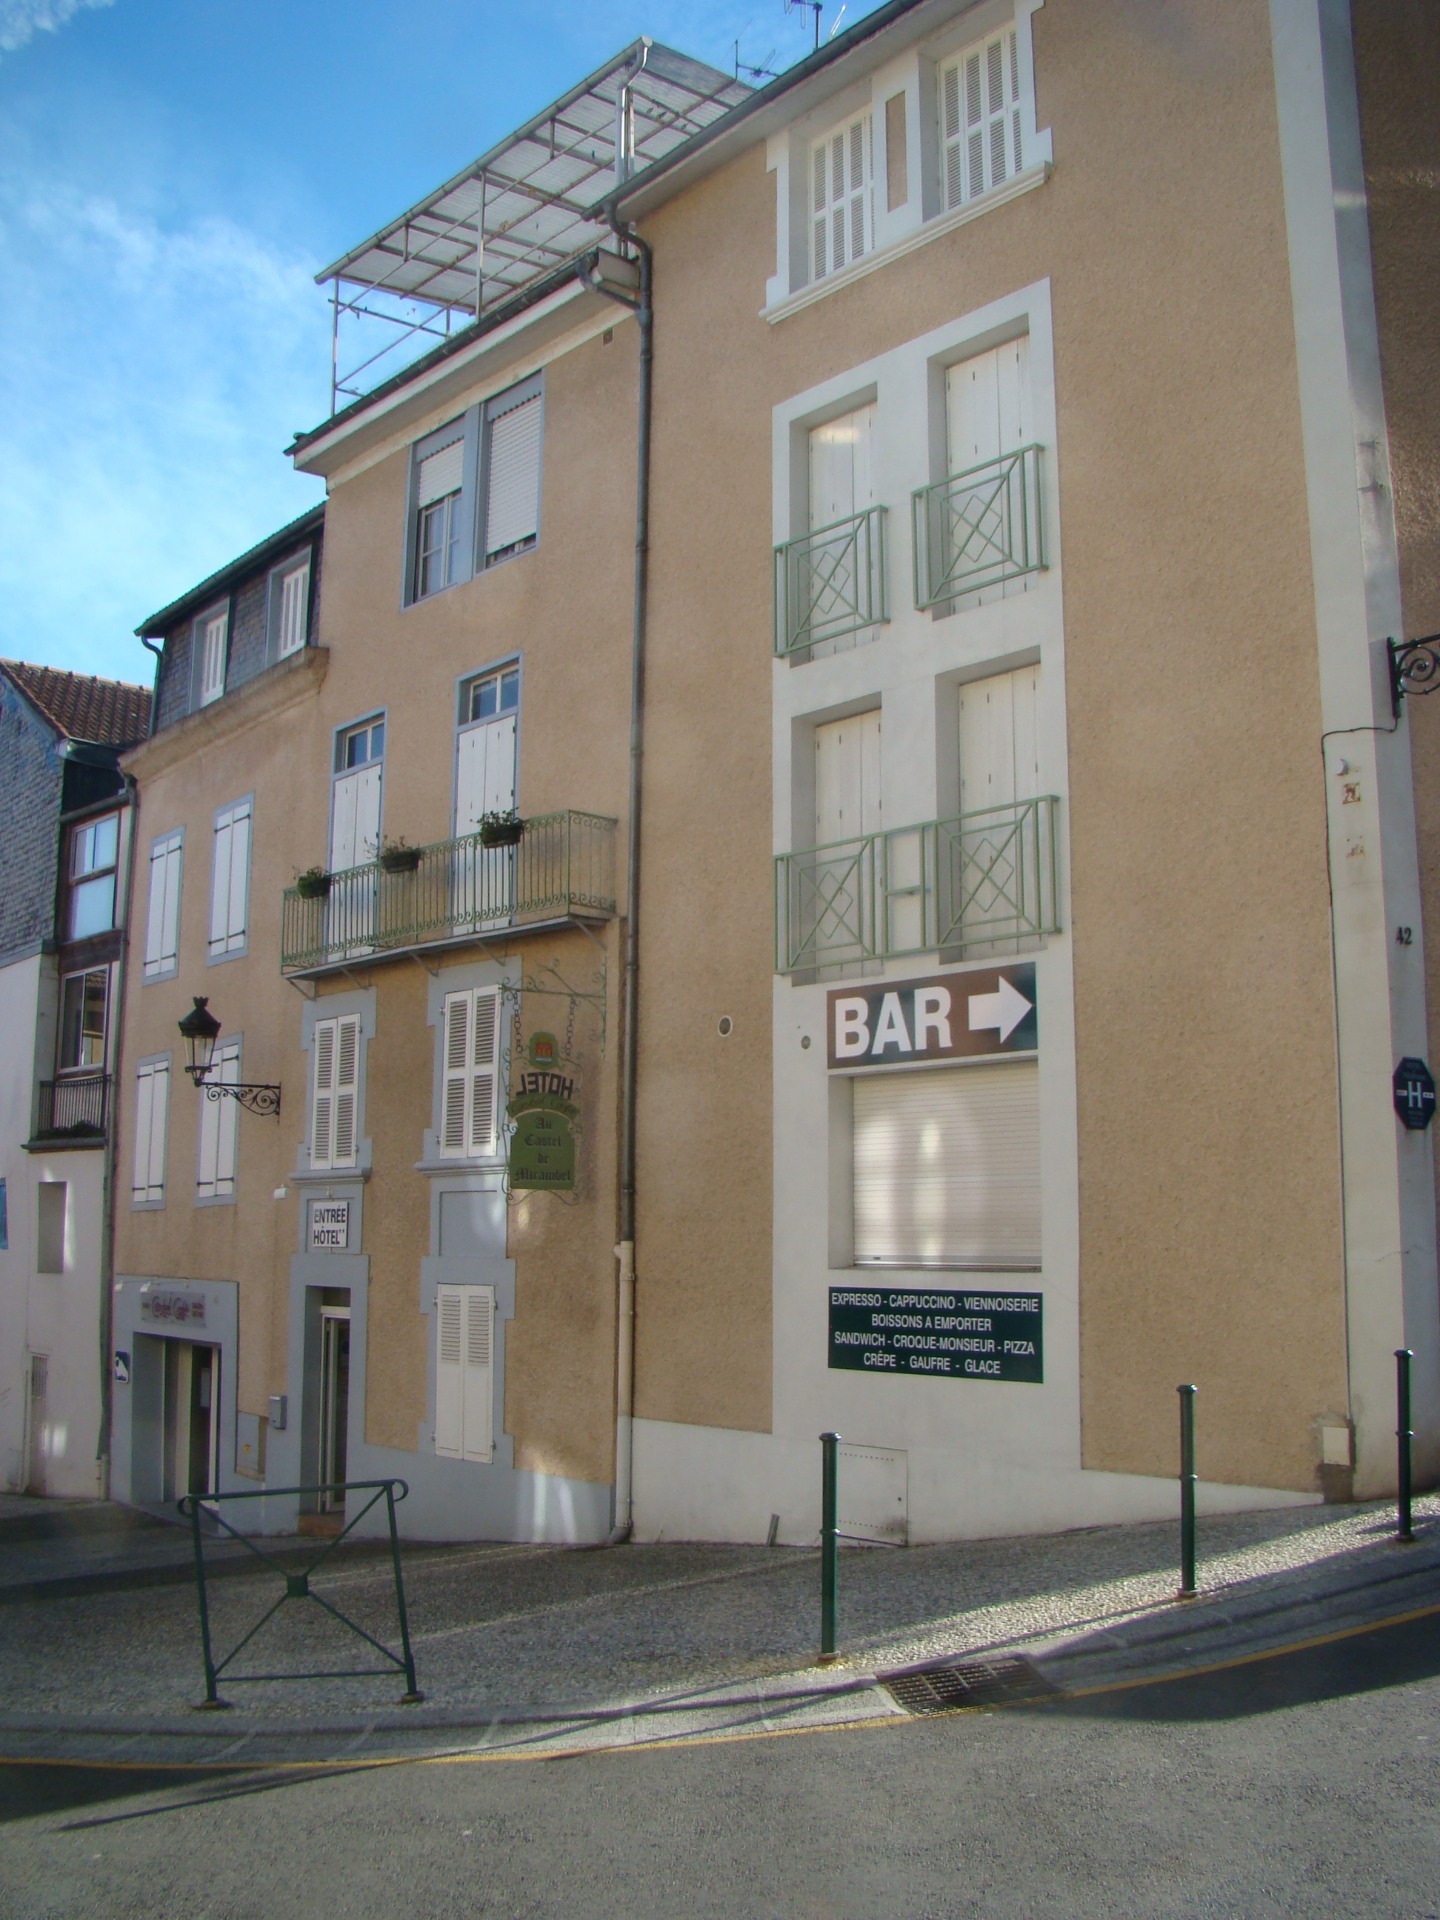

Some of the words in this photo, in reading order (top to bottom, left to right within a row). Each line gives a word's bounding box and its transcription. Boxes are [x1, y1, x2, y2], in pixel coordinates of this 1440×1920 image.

[1396, 926, 1412, 945] 42
[835, 986, 952, 1059] BAR
[1408, 1081, 1423, 1108] H
[314, 1205, 346, 1223] ENTRÉE
[831, 1292, 882, 1307] EXPRESSO
[889, 1294, 956, 1310] CAPPUCCINO
[963, 1297, 1039, 1312] VIENNOISERIE
[871, 1313, 923, 1329] BOISSONS
[924, 1315, 933, 1329] A
[934, 1316, 992, 1331] EMPORTER
[834, 1331, 886, 1347] SANDWICH
[893, 1335, 995, 1353] CROQUE-MONSIEUR
[1003, 1340, 1035, 1355] PIZZA
[863, 1350, 897, 1367] CRÊPE
[909, 1355, 951, 1371] GAUFRE
[964, 1359, 1001, 1374] GLACE
